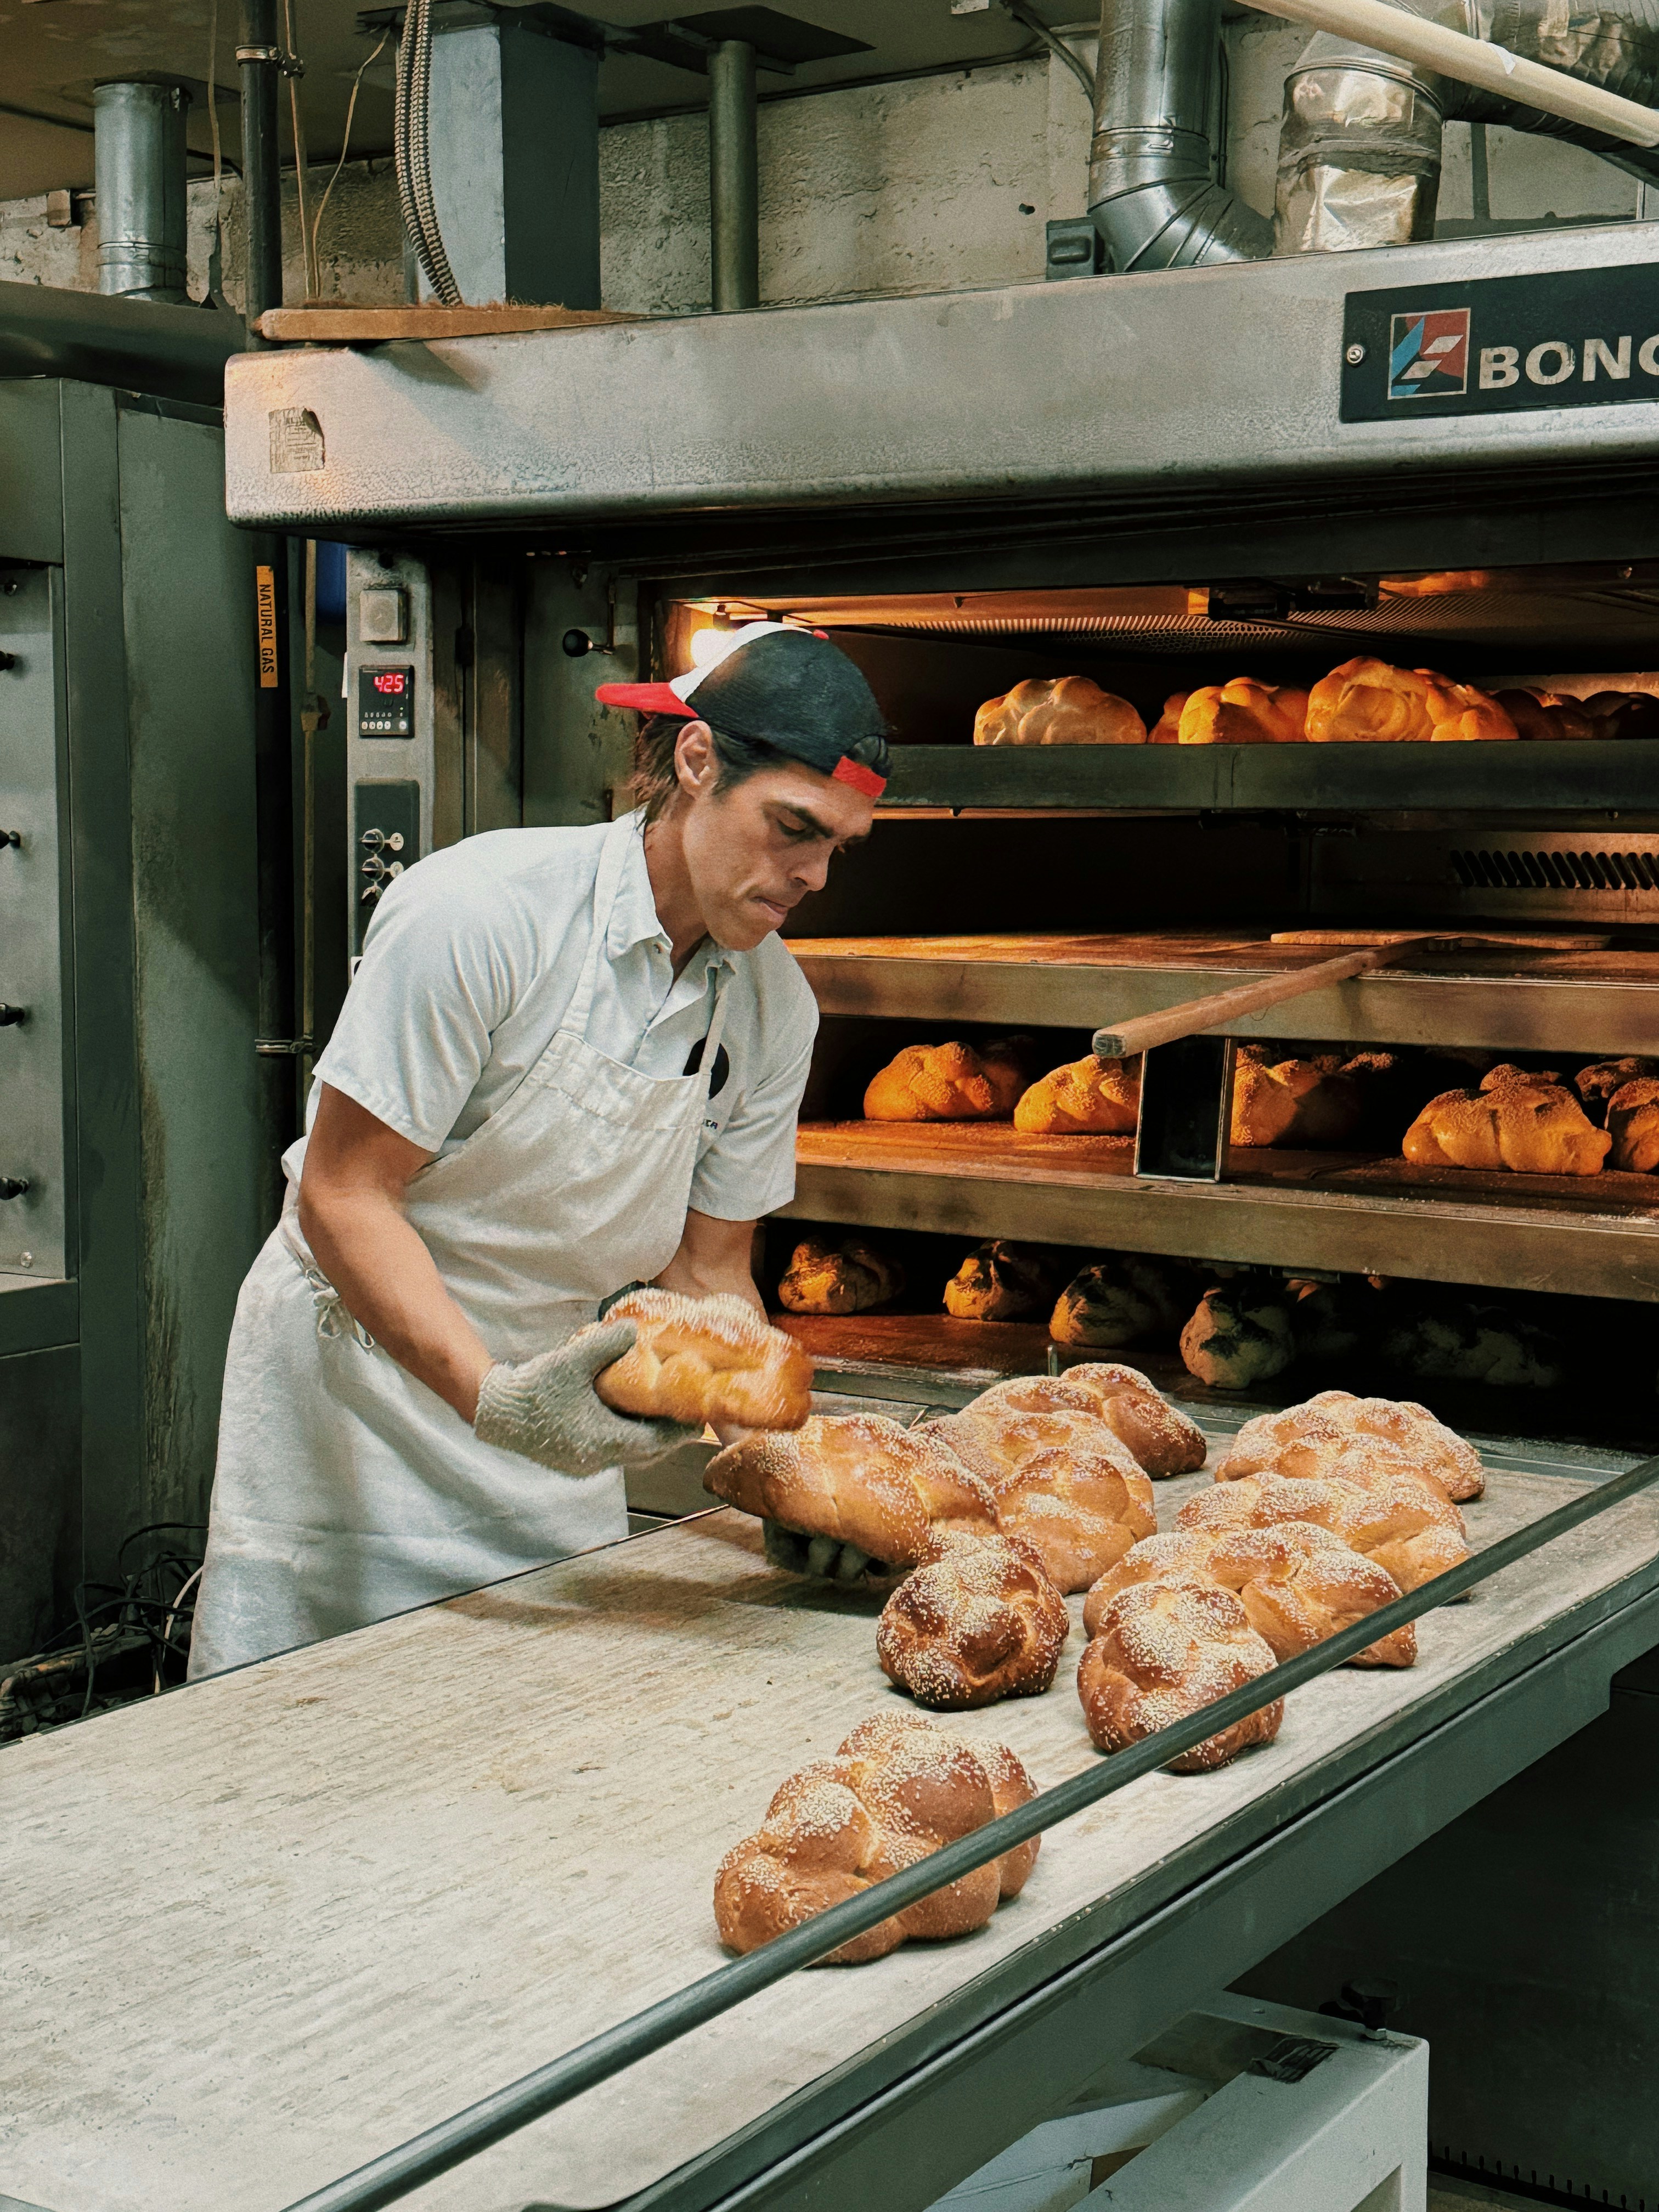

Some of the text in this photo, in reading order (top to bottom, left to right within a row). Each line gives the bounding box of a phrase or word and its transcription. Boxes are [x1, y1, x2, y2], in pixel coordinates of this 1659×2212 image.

[259, 584, 274, 674] NATURAL GAS
[374, 674, 404, 692] 425
